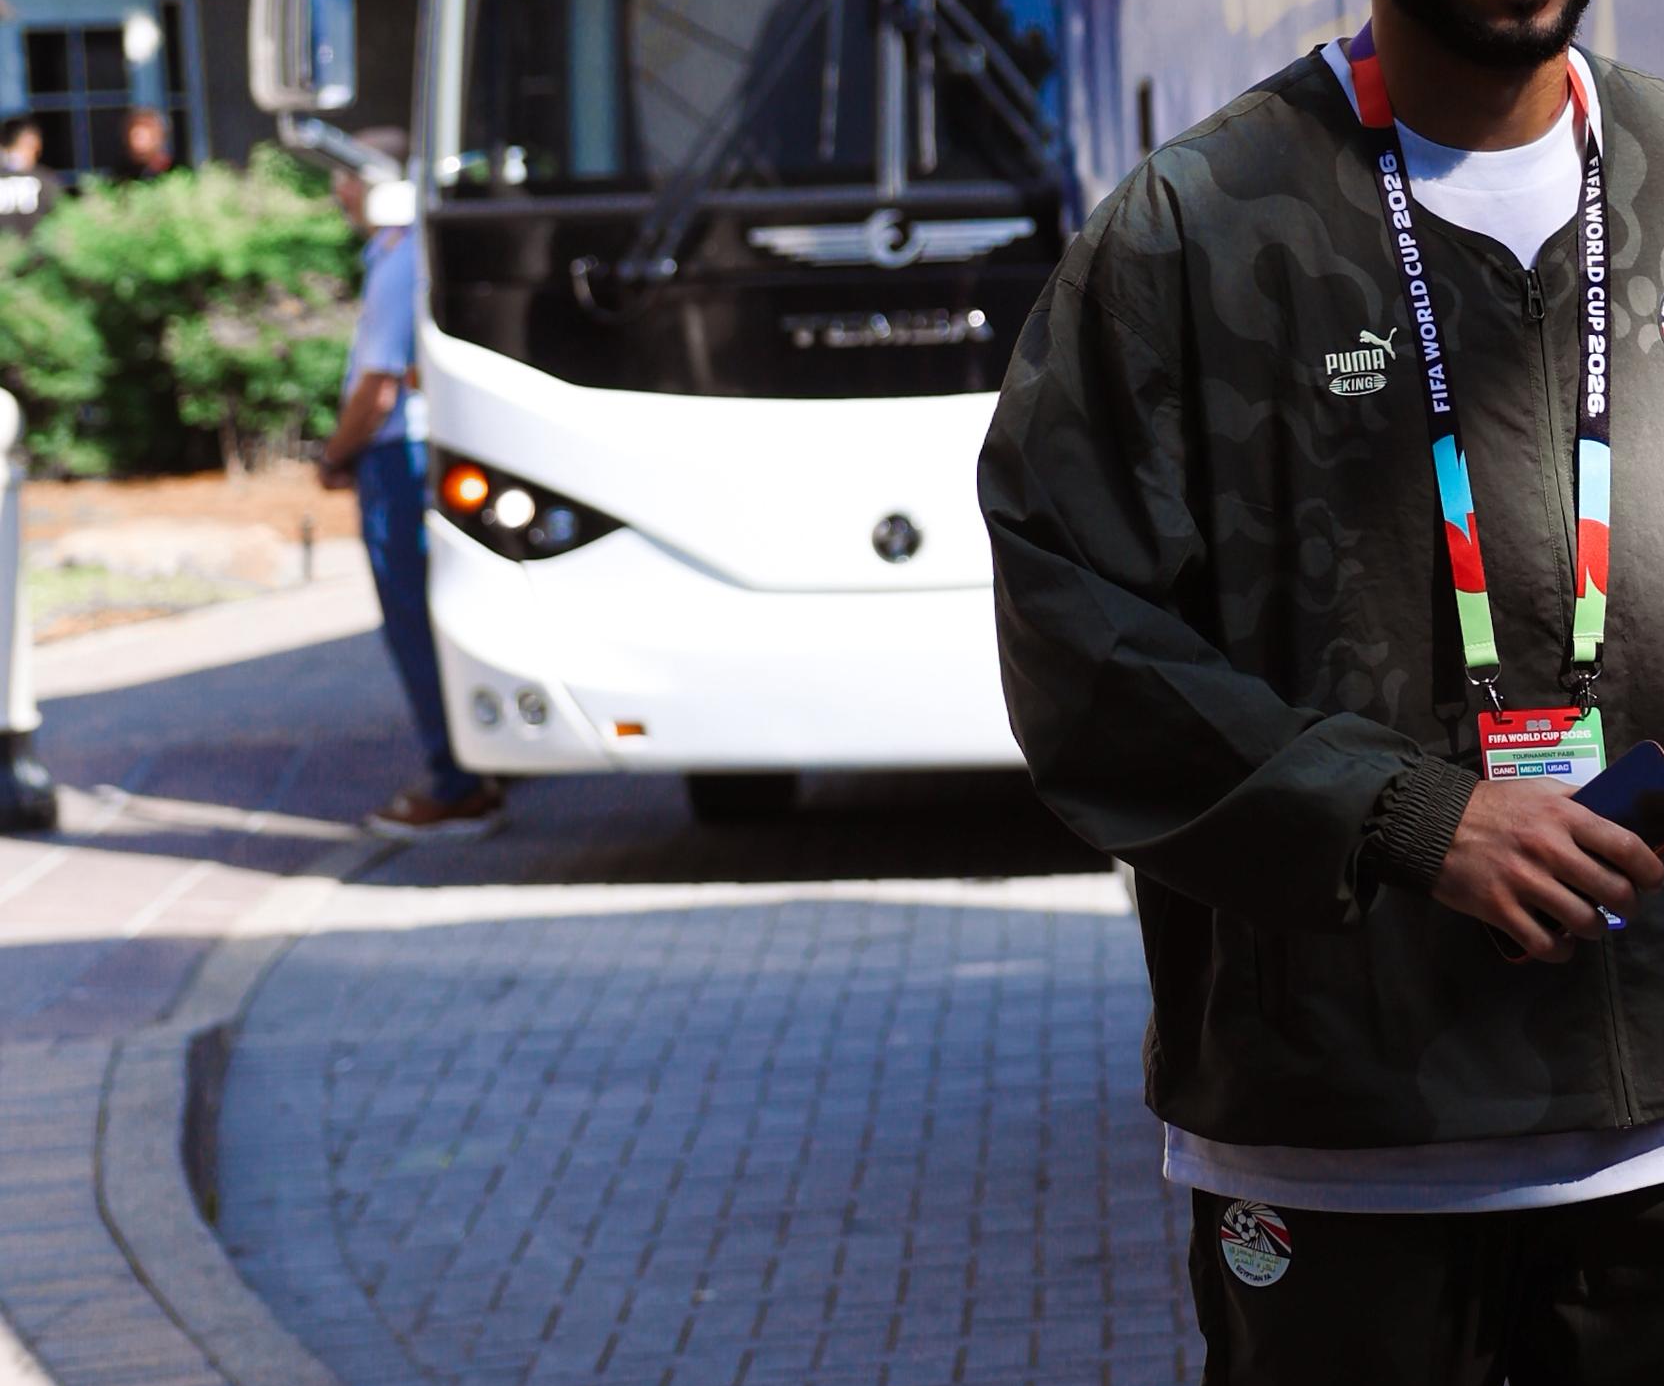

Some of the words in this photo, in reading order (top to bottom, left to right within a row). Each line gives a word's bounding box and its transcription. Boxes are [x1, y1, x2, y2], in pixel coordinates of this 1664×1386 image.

[1379, 153, 1412, 230] 2026
[1585, 155, 1601, 202] FIFA
[1398, 232, 1423, 277] CUP
[1585, 202, 1605, 283] WORLD
[1409, 279, 1441, 362] WORLD
[1587, 286, 1605, 331] CUP
[1325, 348, 1385, 375] PUMA
[1342, 376, 1374, 392] KING
[1587, 334, 1606, 414] 2026
[1428, 363, 1451, 413] FIFA
[1488, 733, 1509, 744] FIFA
[1509, 732, 1540, 743] WORLD
[1541, 731, 1560, 741] CUP
[1560, 729, 1592, 740] 2026
[1512, 752, 1556, 760] TOURNAMENT
[1557, 750, 1575, 758] PASS
